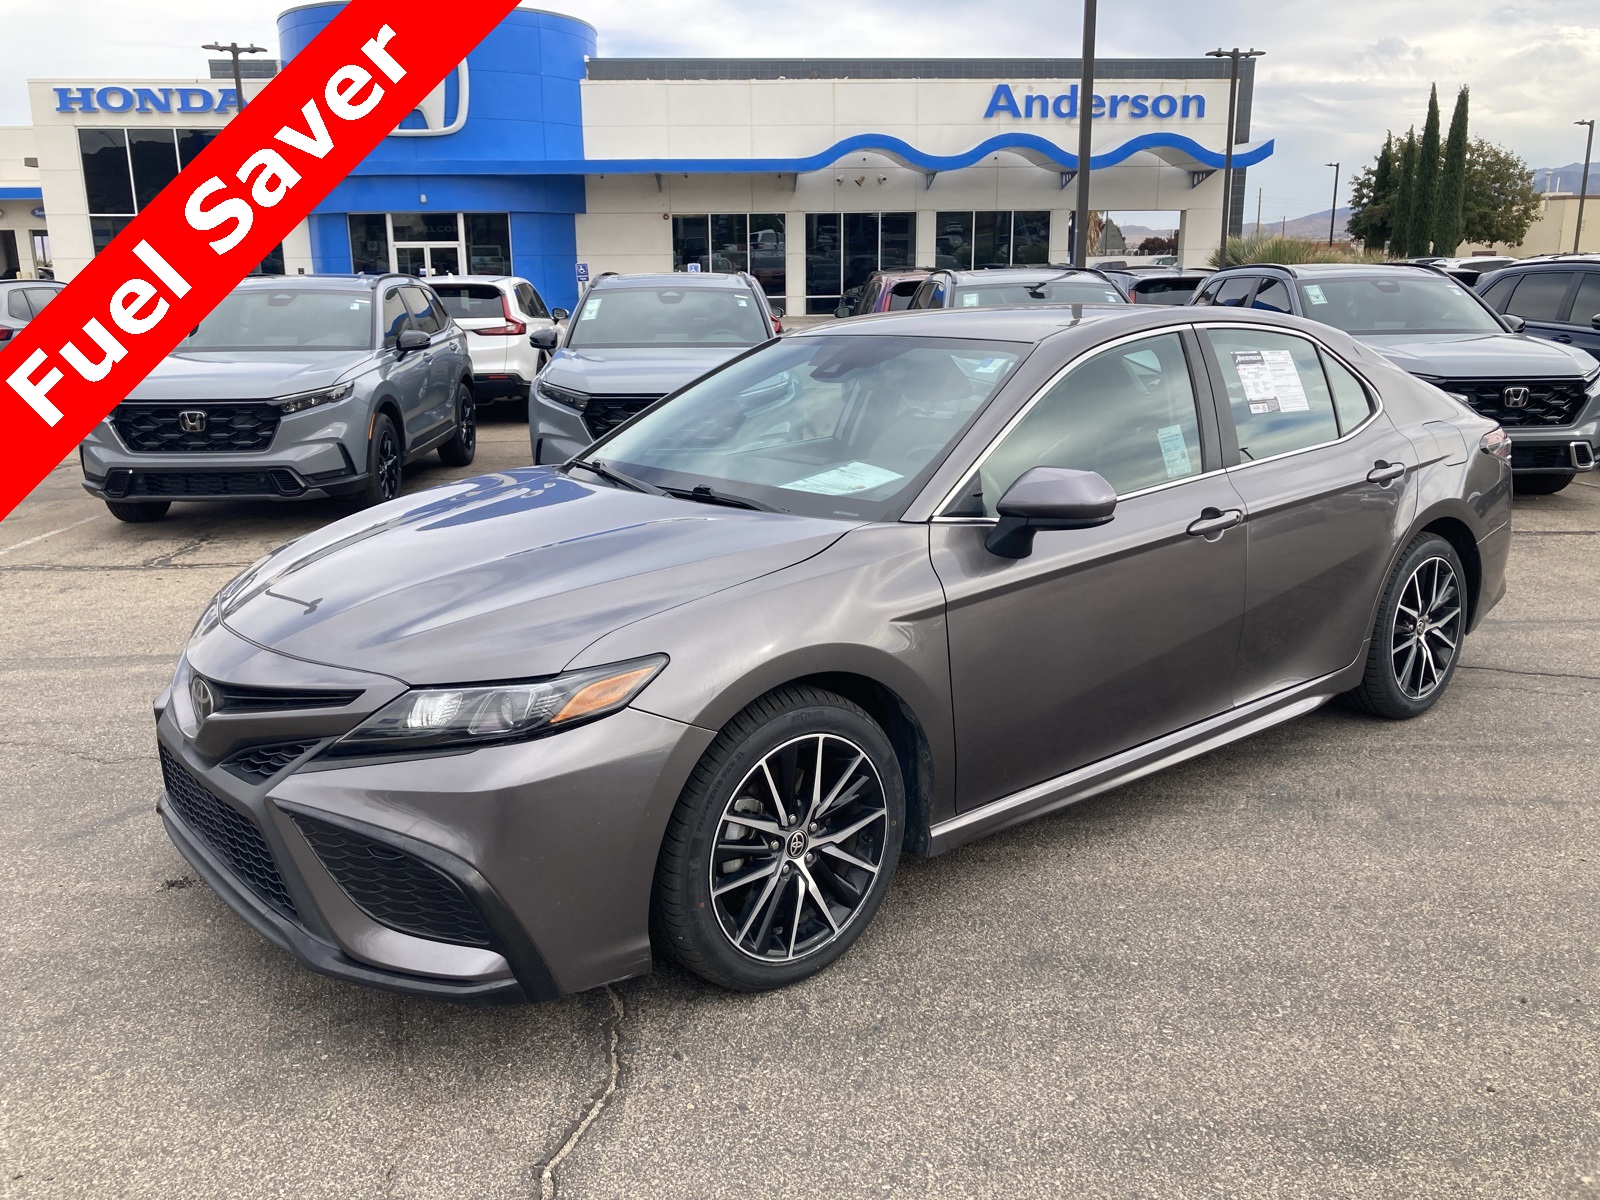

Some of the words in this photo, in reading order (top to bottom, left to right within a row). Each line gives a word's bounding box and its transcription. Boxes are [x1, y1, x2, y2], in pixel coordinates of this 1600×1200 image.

[53, 86, 249, 113] HONDA
[983, 84, 1206, 119] Anderson
[413, 225, 467, 233] WELCO
